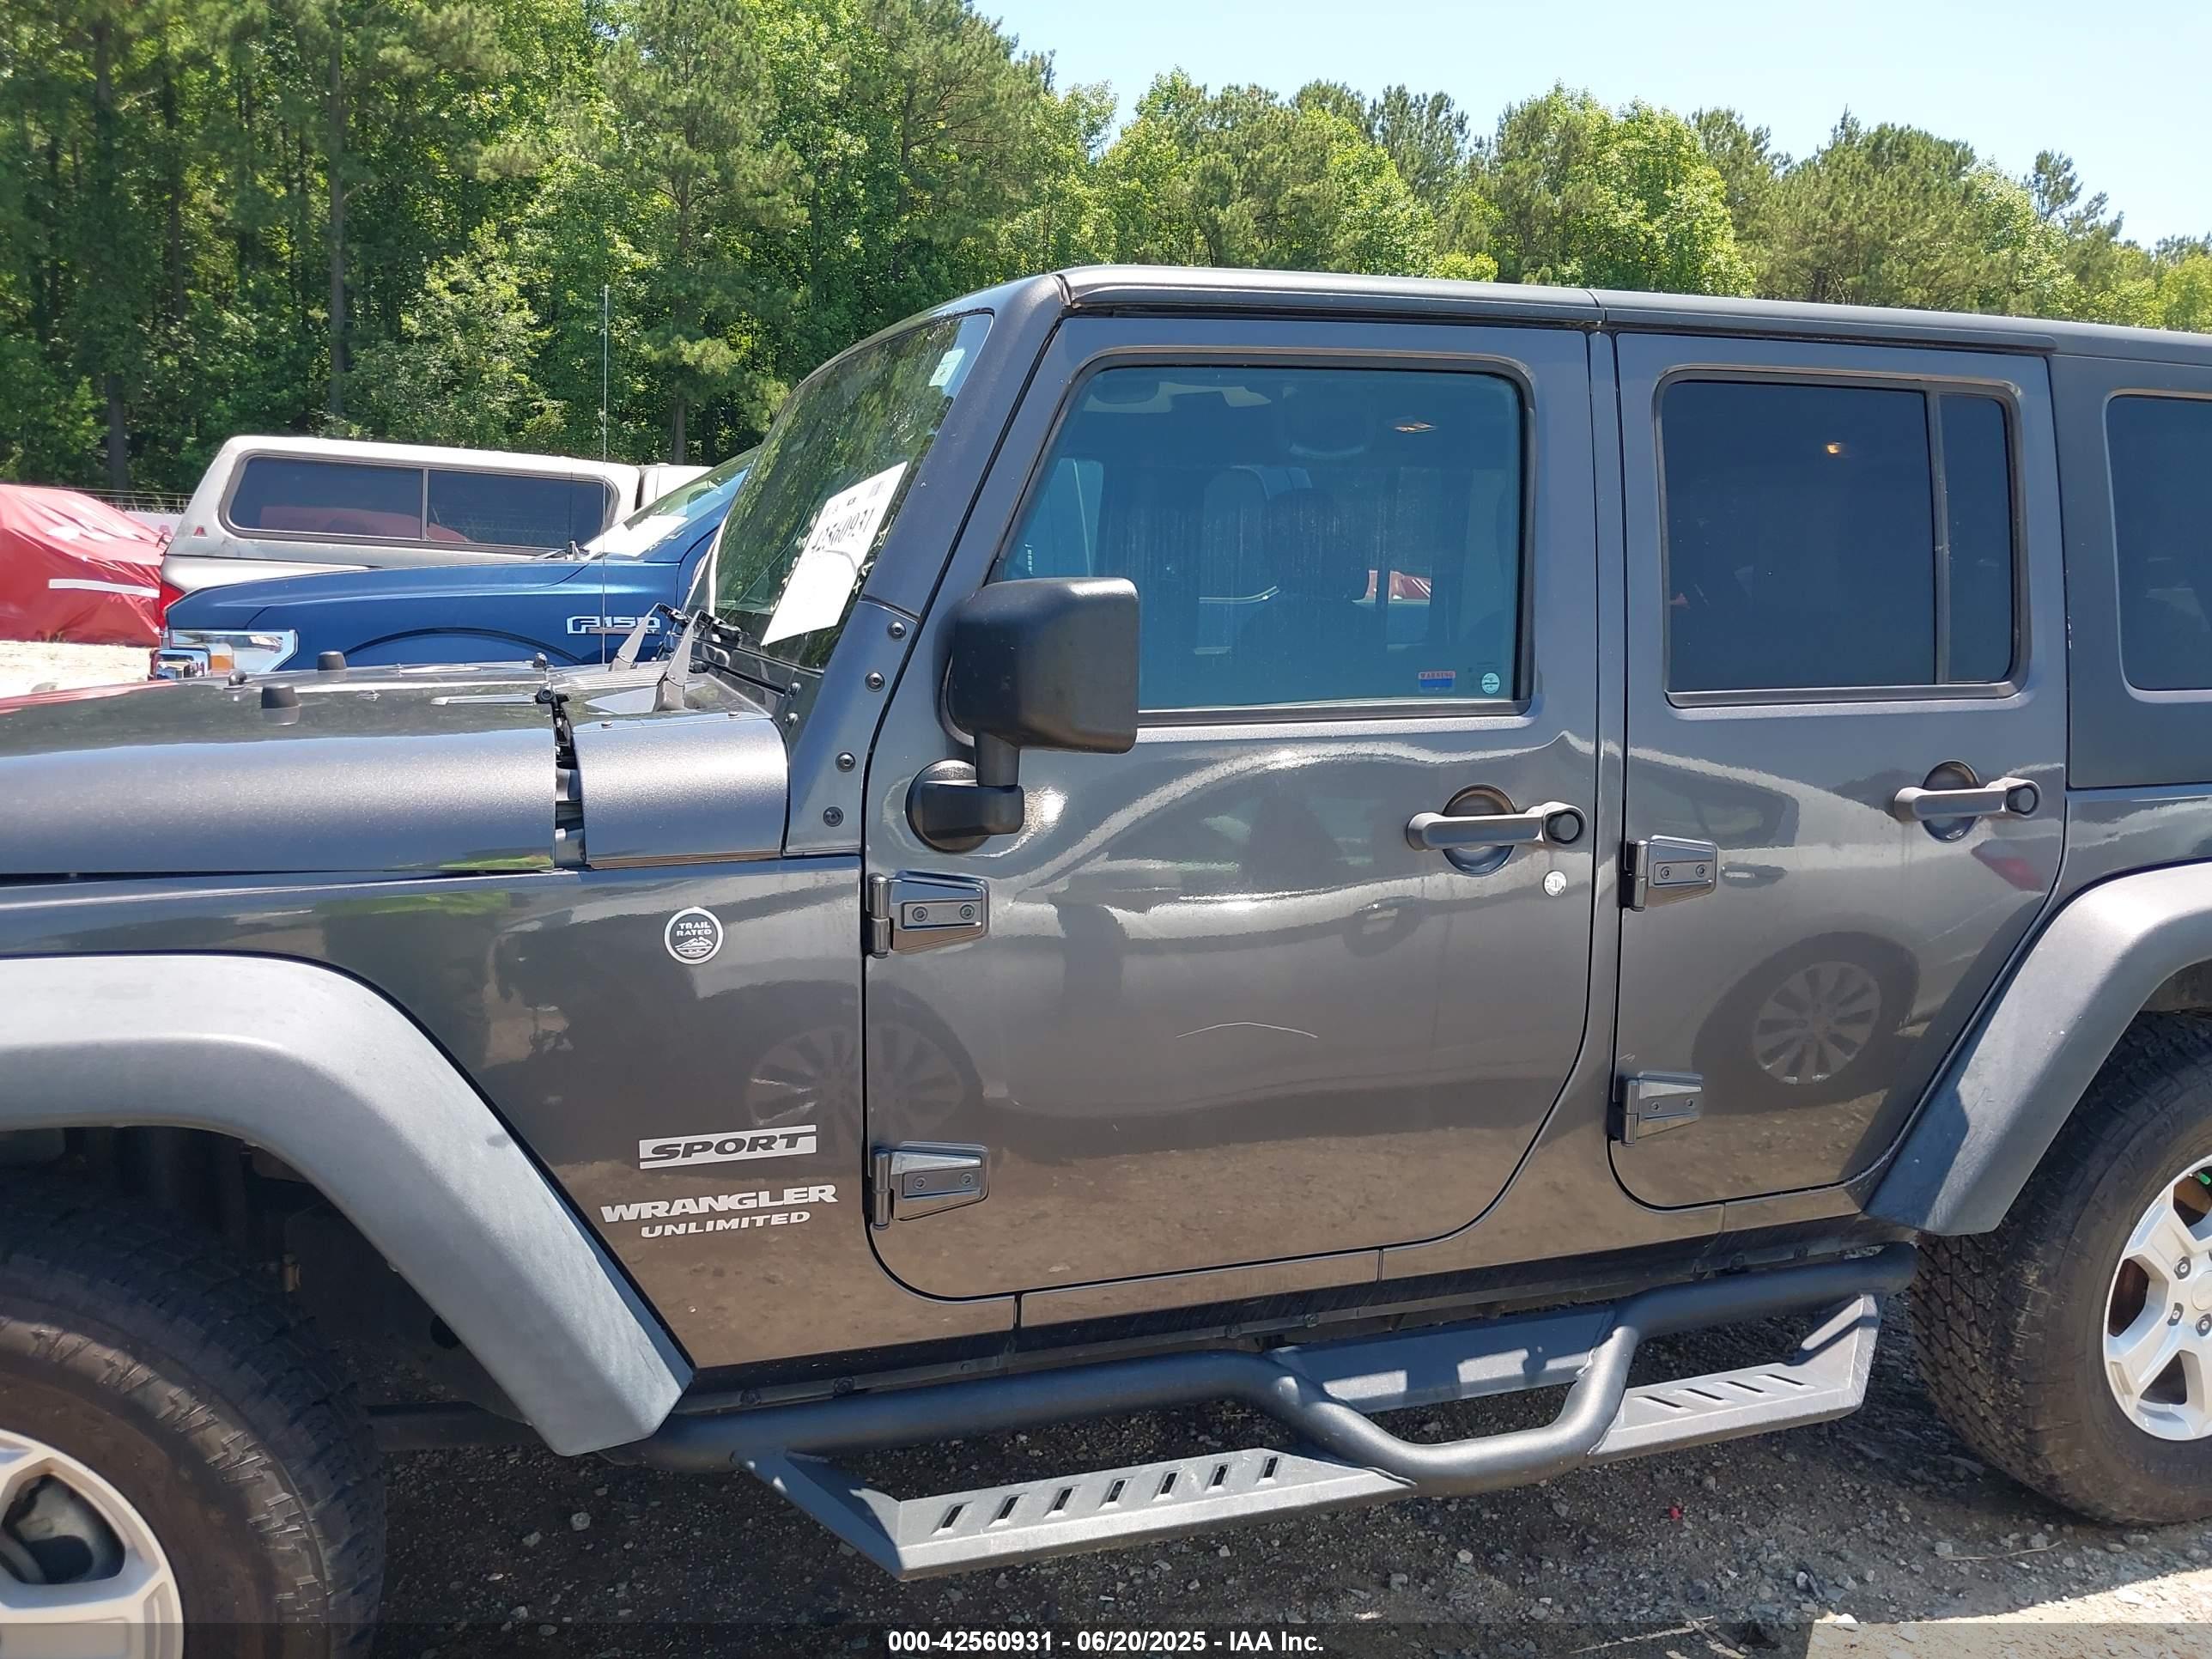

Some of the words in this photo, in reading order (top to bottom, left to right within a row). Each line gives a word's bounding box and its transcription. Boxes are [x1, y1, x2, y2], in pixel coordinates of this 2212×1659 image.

[676, 928, 713, 937] RATED
[678, 921, 711, 930] TRAIL
[641, 1131, 817, 1162] SPORT
[600, 1184, 839, 1223] WRANGLER
[641, 1211, 811, 1238] UNLIMITED
